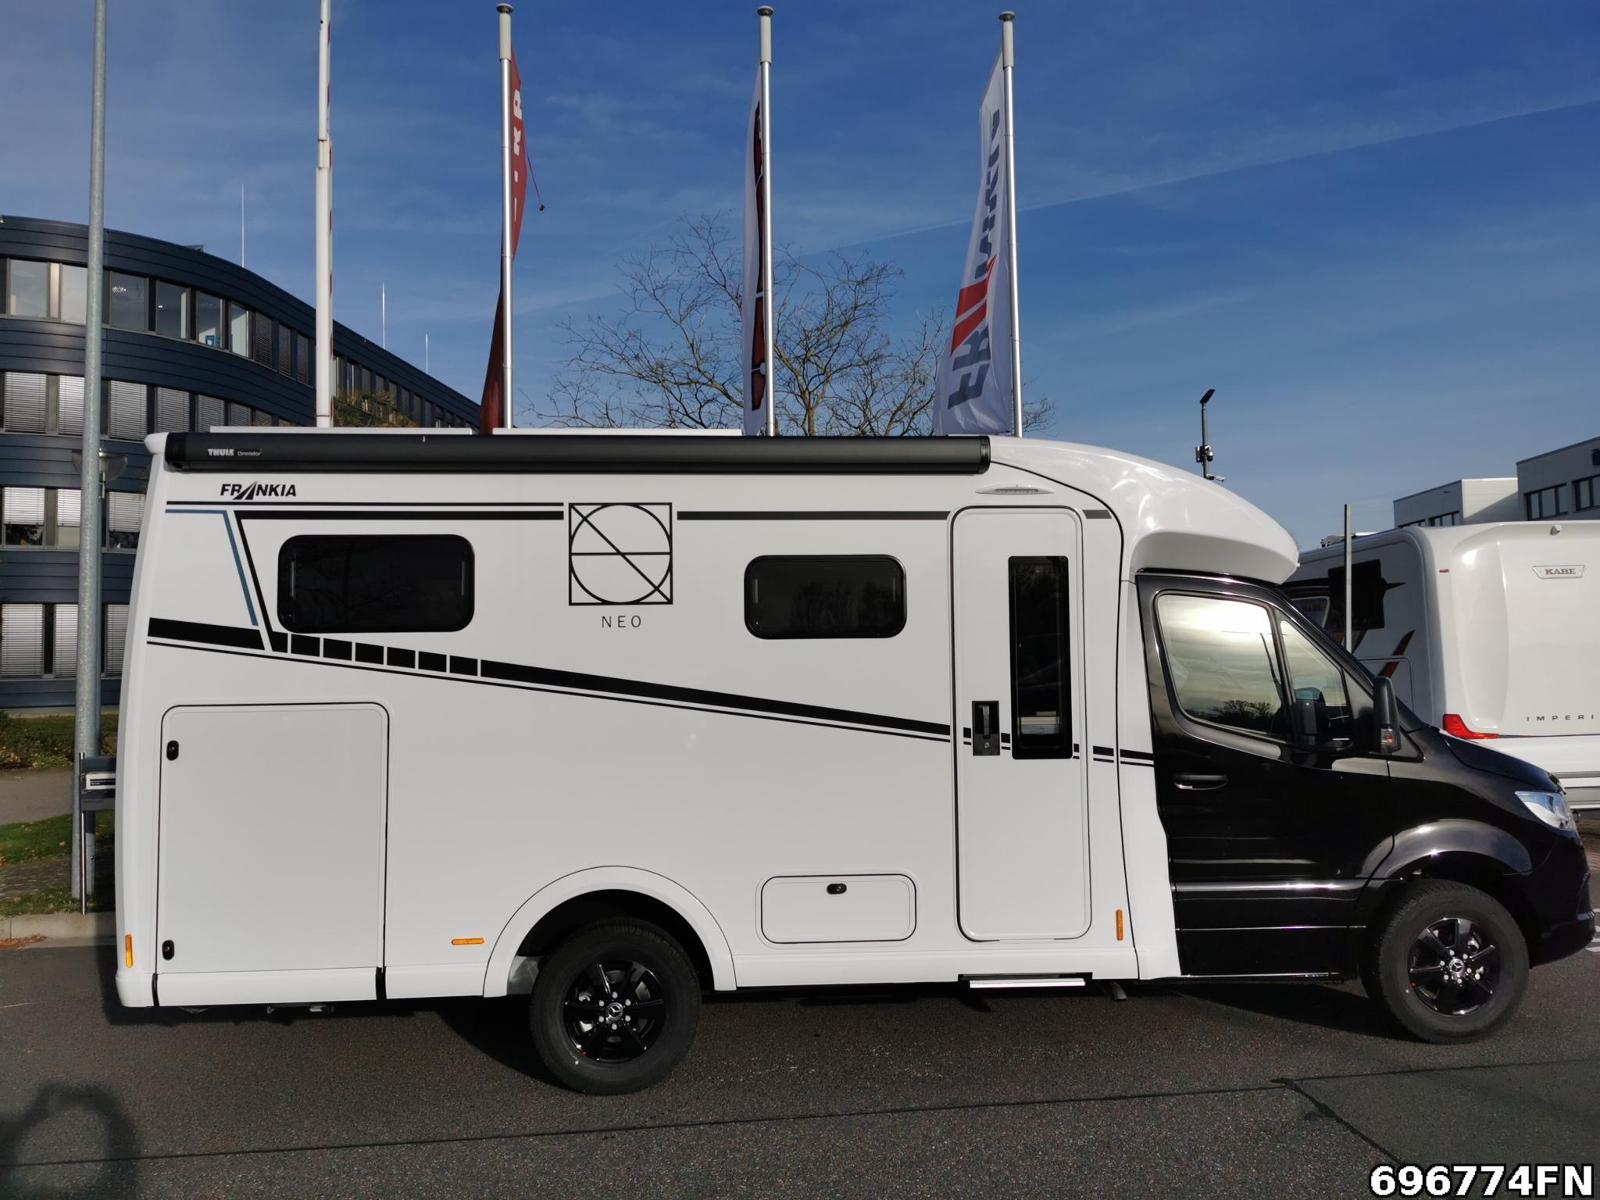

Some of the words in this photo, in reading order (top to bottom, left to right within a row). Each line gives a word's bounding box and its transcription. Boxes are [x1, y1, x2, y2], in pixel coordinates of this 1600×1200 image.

[207, 448, 235, 457] THULE
[220, 481, 297, 500] FRANKIA
[1544, 567, 1577, 576] KABE
[601, 615, 642, 628] NEO
[1526, 714, 1595, 722] IMPERI
